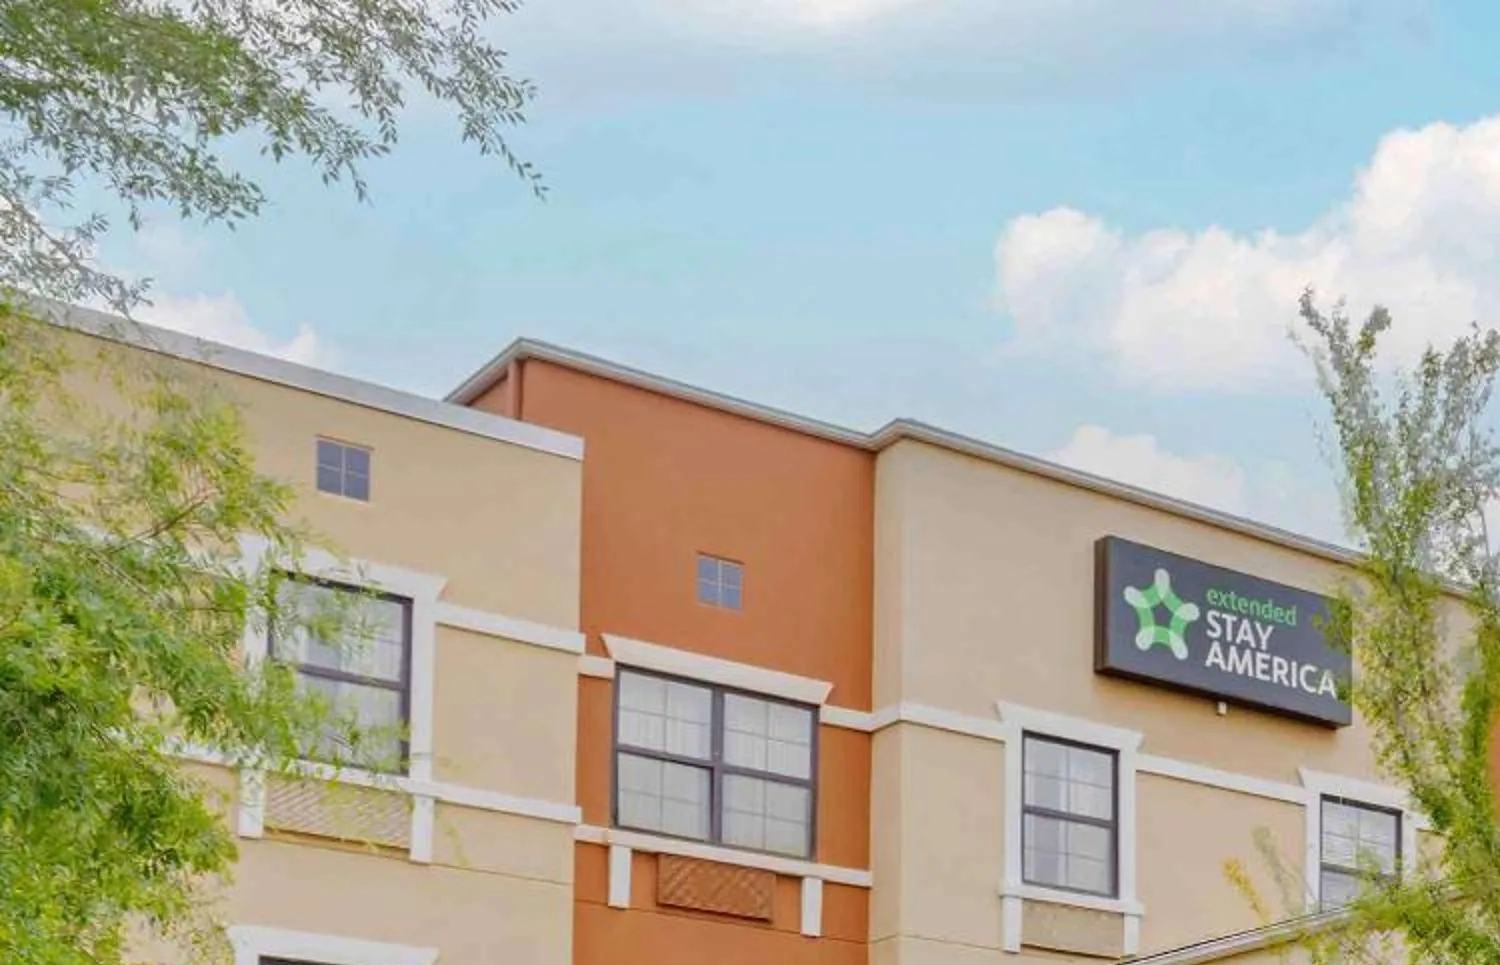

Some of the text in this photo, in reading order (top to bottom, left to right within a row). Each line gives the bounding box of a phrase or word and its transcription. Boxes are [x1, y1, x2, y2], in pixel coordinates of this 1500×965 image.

[1206, 588, 1297, 626] extended
[1206, 610, 1274, 650] STAY
[1205, 641, 1337, 699] AMERICA
